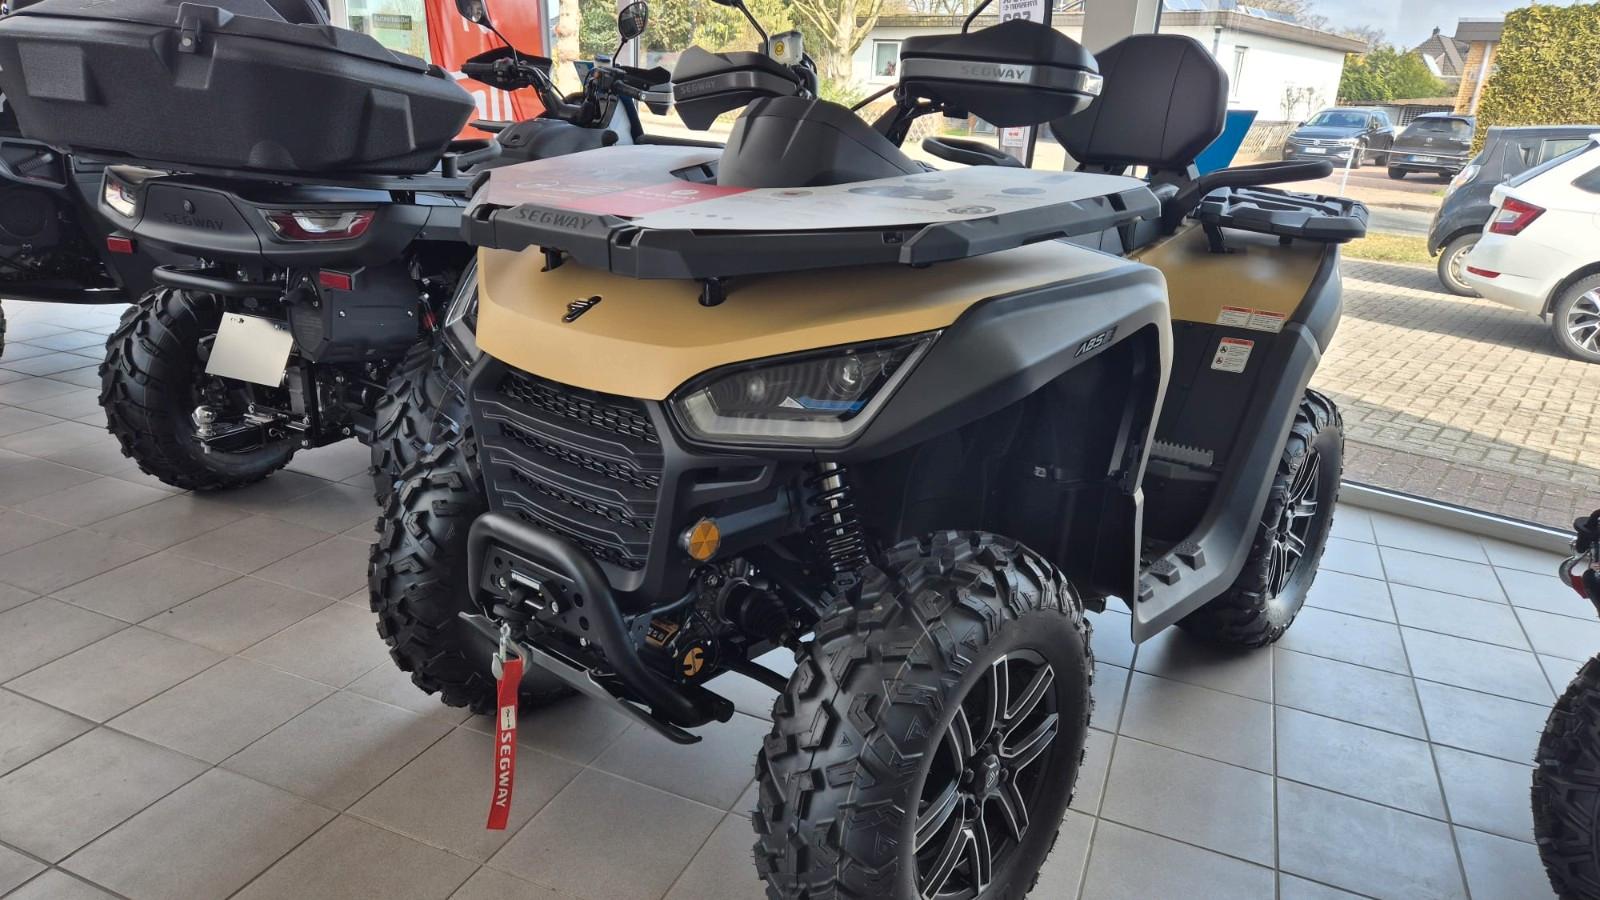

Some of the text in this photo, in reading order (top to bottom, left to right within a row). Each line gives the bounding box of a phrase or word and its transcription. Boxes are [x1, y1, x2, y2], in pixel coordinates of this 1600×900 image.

[961, 64, 1025, 79] SEGWAY
[680, 80, 716, 94] SEGWAY
[163, 212, 224, 230] SEGWAY
[515, 208, 593, 229] SEGWAY
[496, 732, 512, 808] SEGWAY
